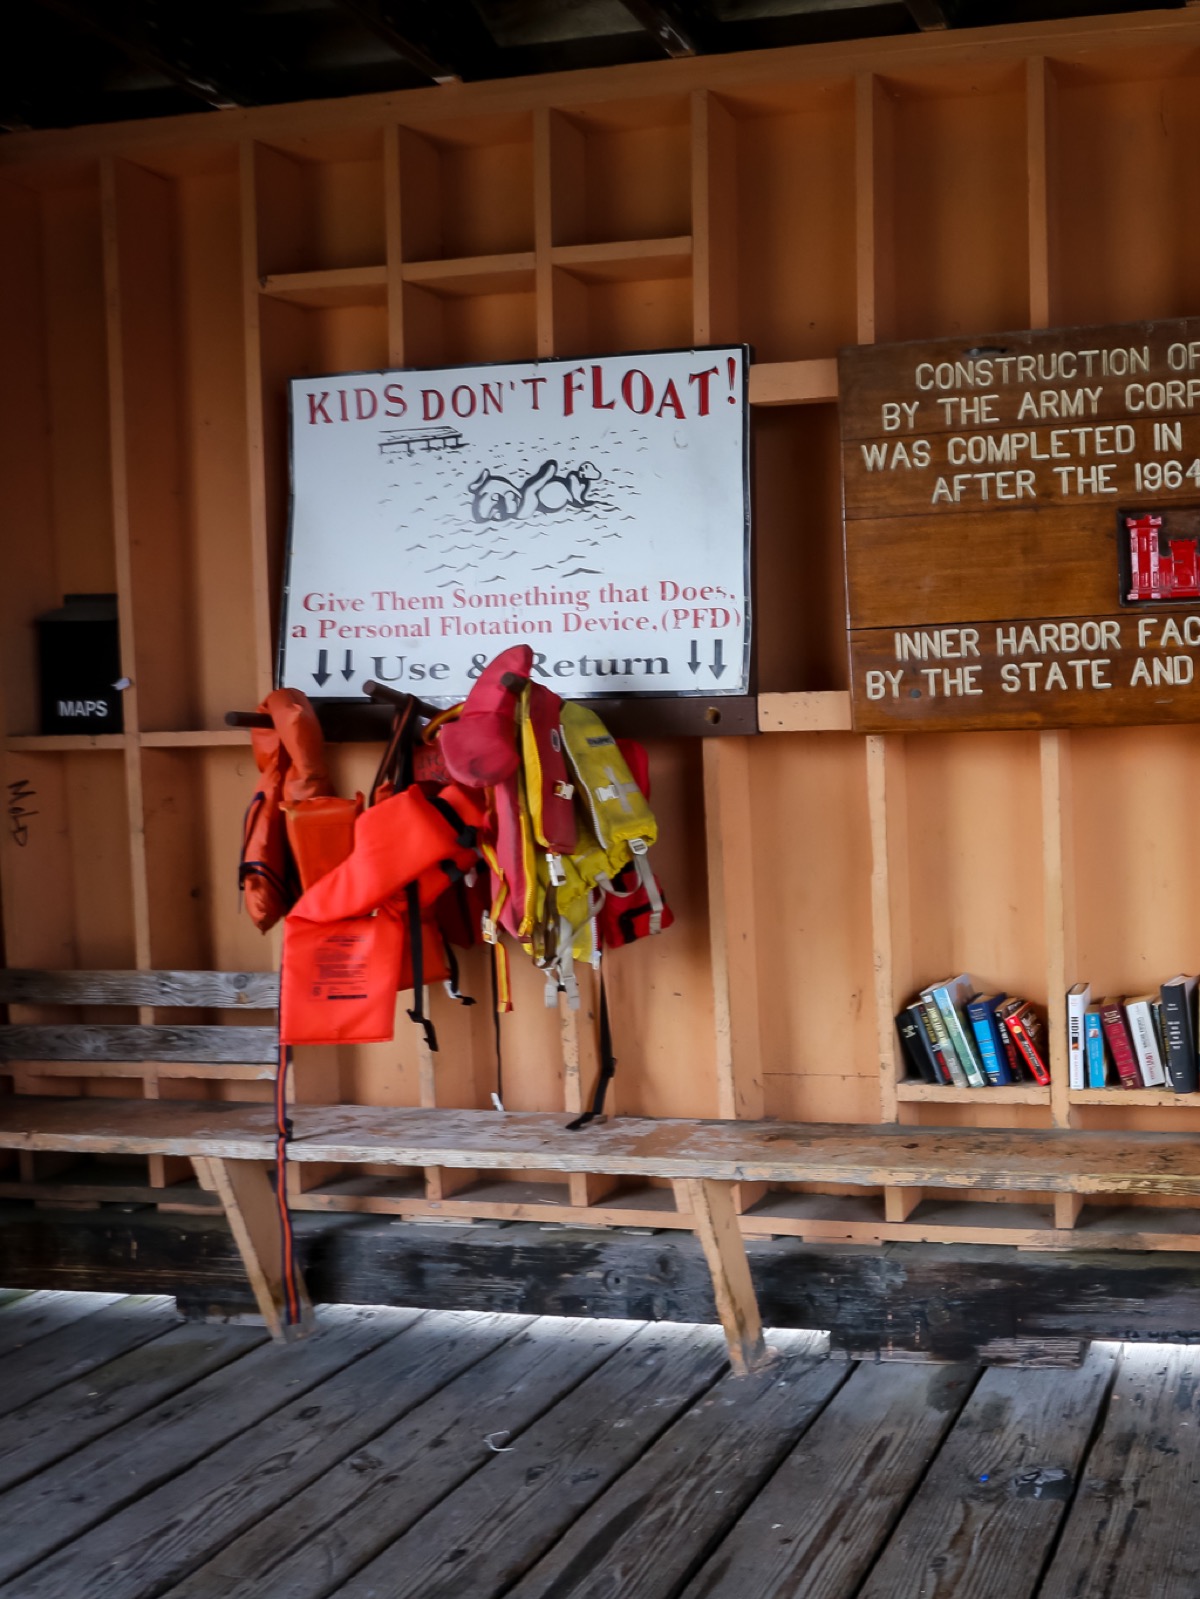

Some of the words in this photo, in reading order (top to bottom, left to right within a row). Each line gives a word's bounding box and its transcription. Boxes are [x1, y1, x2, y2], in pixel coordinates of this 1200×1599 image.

[915, 346, 1150, 391] CONSTRUCTION
[307, 383, 408, 425] KIDS
[421, 377, 547, 421] DON'T
[562, 356, 737, 420] FLOAT!
[882, 401, 920, 431] BY
[937, 395, 1001, 427] THE
[1018, 386, 1104, 421] ARMY
[861, 439, 931, 471] WAS
[947, 424, 1136, 466] COMPLETED
[1153, 422, 1183, 452] IN
[931, 470, 1037, 504] AFTER
[1053, 463, 1118, 496] THE
[302, 592, 365, 613] Give
[371, 590, 447, 612] Them
[452, 584, 590, 613] Something
[599, 582, 649, 604] that
[291, 624, 307, 639] a
[319, 617, 430, 639] Personal
[440, 614, 552, 637] Flotation
[894, 629, 980, 661] INNER
[996, 620, 1122, 657] HARBOR
[370, 654, 451, 682] Use
[466, 652, 491, 680] &
[530, 650, 670, 680] Return
[865, 669, 902, 700] BY
[922, 665, 984, 697] THE
[1001, 659, 1113, 693] STATE
[1130, 654, 1194, 687] AND
[57, 700, 108, 717] MAPS
[1070, 1016, 1079, 1037] HIDE
